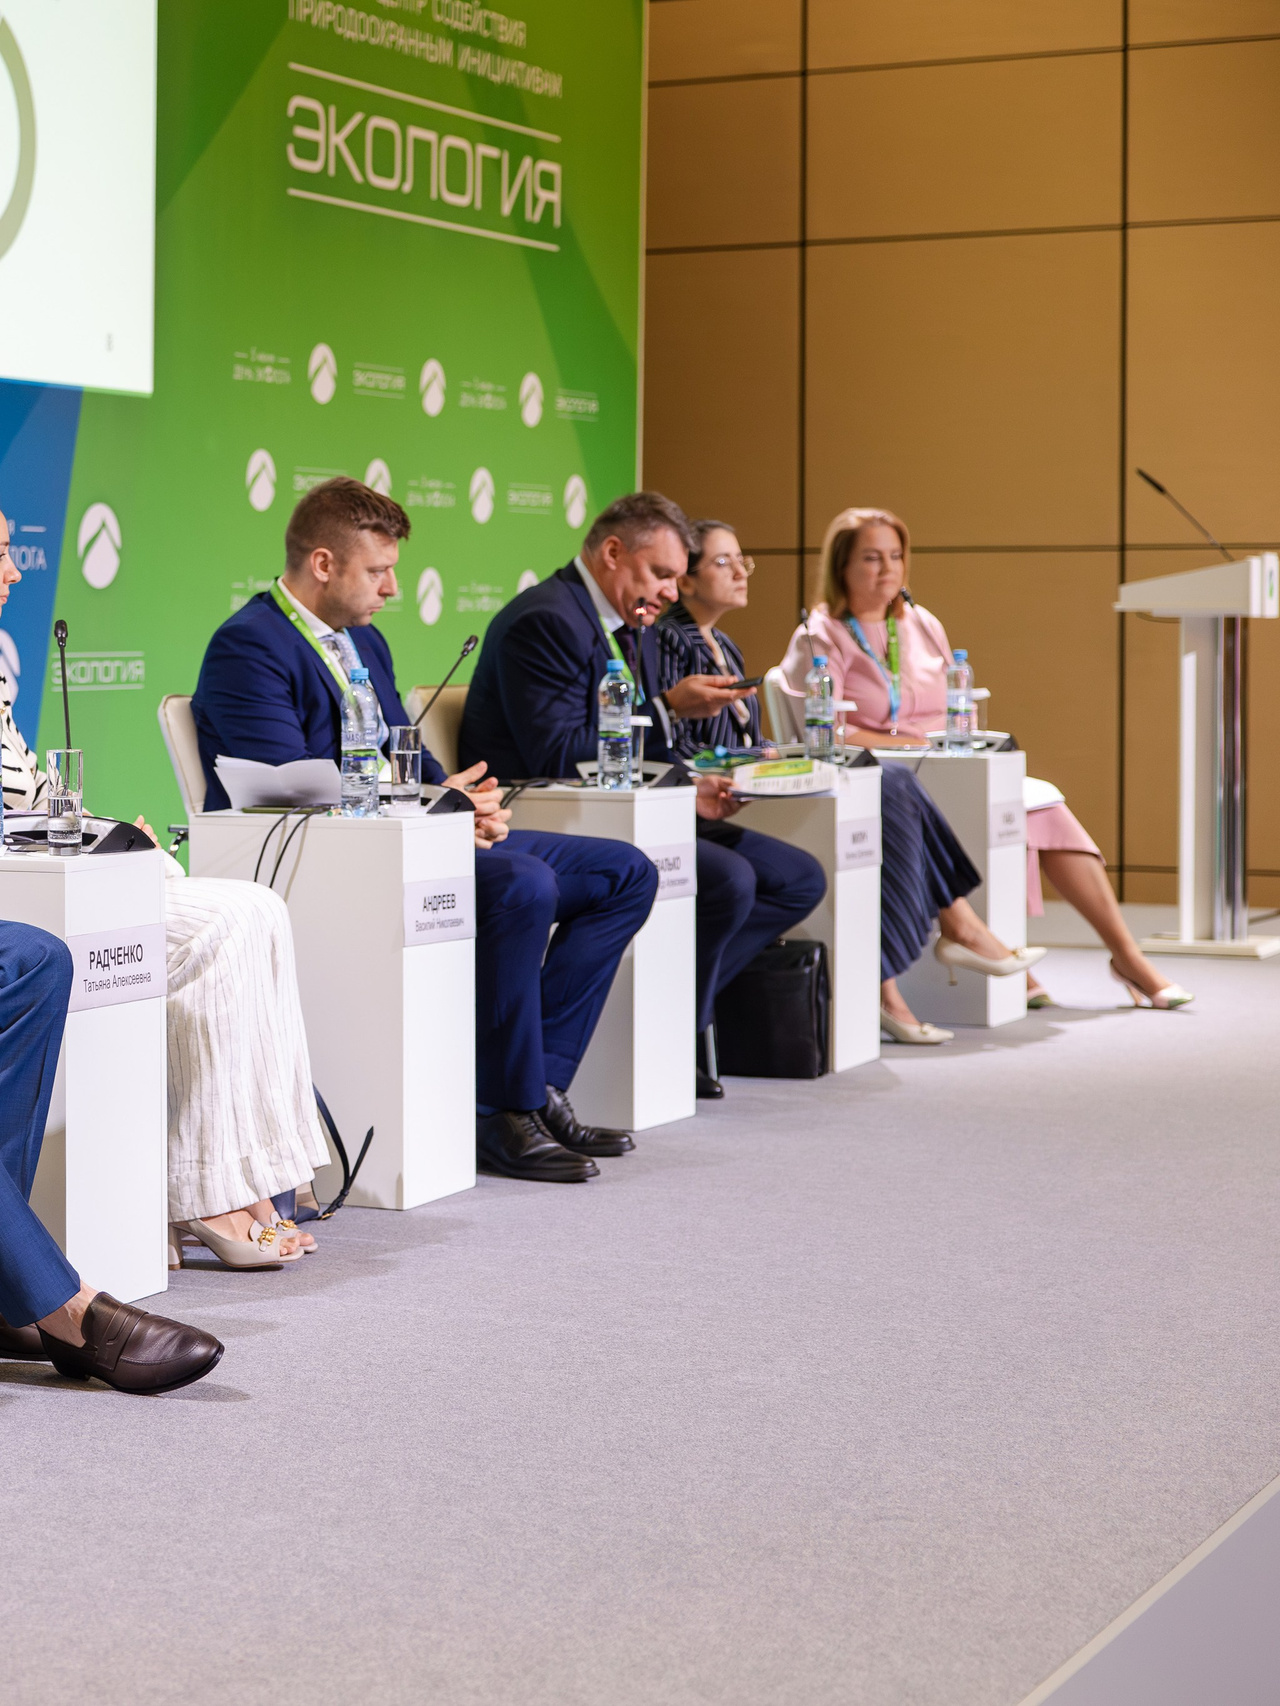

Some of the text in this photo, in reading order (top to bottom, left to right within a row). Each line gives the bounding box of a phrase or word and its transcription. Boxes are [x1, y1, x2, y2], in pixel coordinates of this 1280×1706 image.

[288, 0, 455, 68] ПРИРОДООХРАННЫМ
[287, 95, 562, 228] ЭКОЛОГИЯ
[9, 545, 48, 571] ЛОГА
[51, 659, 146, 685] ЭКОЛОГИЯ
[422, 893, 457, 914] АНДРЕЕВ
[88, 943, 144, 972] РАДЧЕНКО
[83, 971, 152, 994] Татьяна Алексеевна
